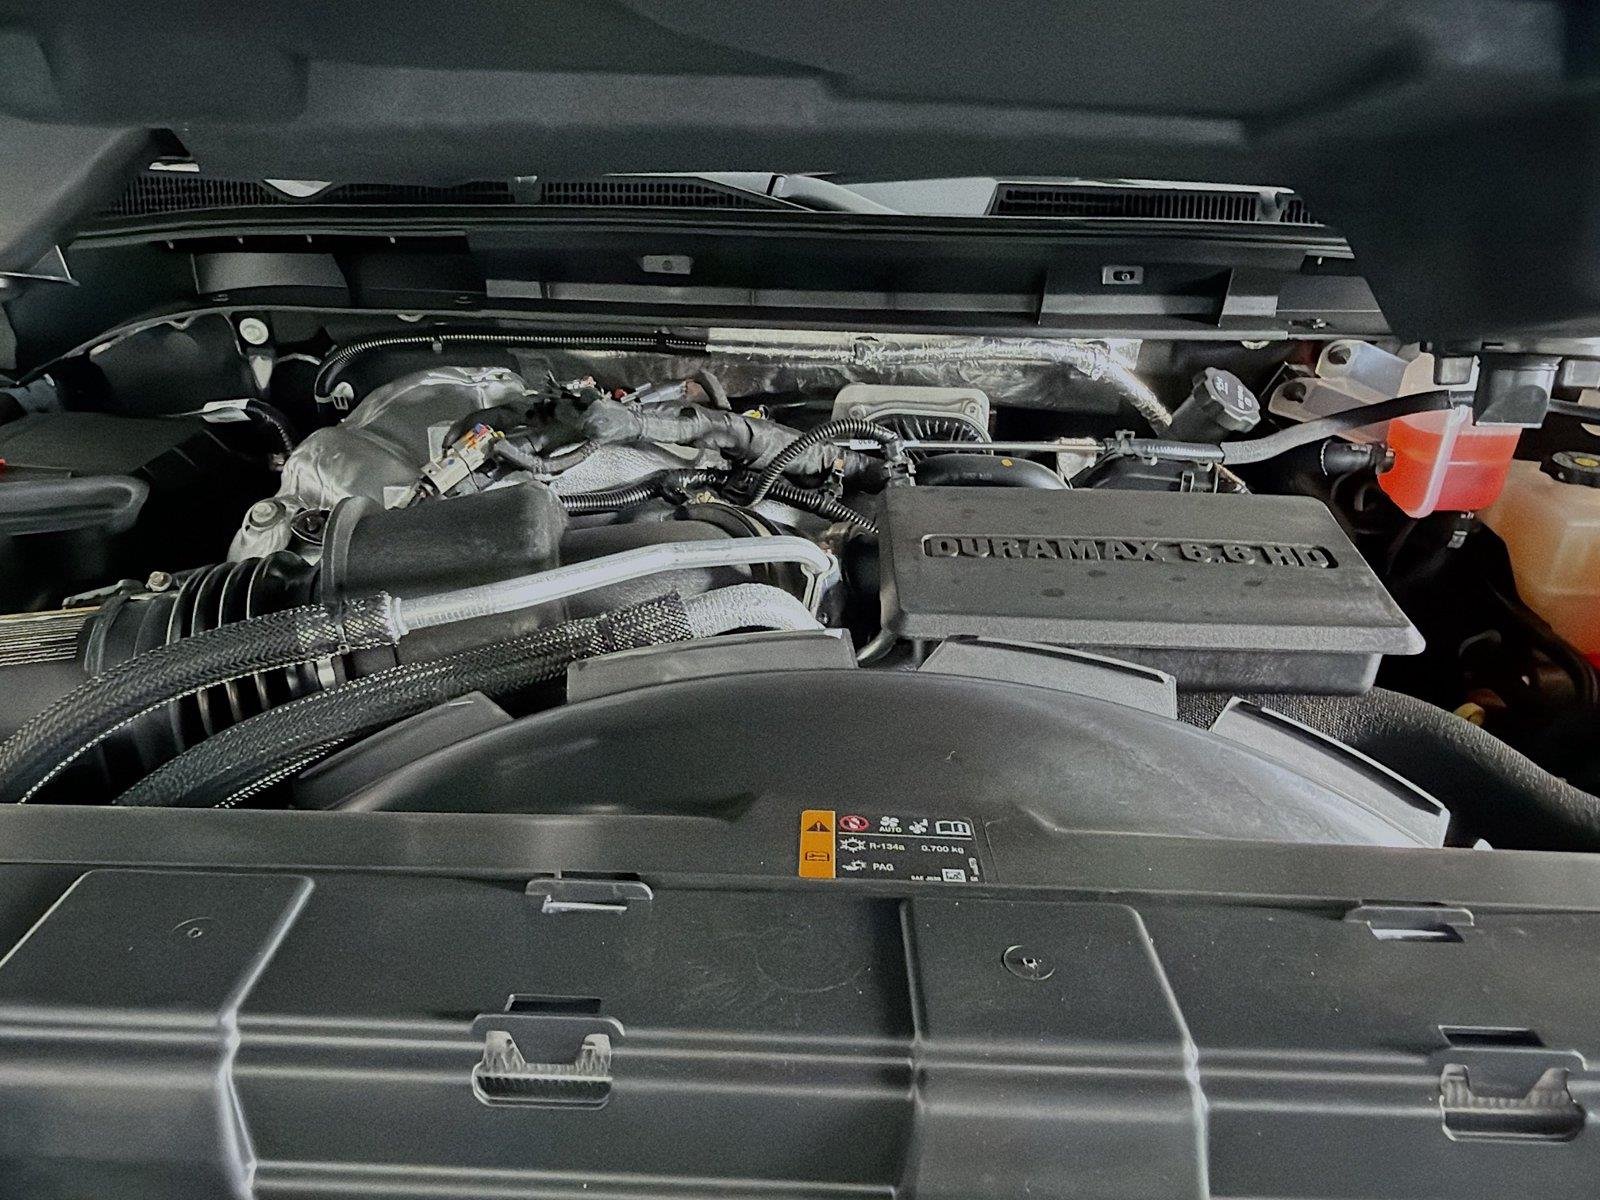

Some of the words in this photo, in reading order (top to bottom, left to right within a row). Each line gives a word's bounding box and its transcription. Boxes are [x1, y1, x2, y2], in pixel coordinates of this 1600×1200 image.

[930, 537, 1165, 562] DURAMAX
[1180, 543, 1255, 565] 6.6
[1263, 545, 1330, 568] HD
[869, 842, 905, 851] R-134a
[921, 845, 949, 853] 0.700
[951, 846, 964, 855] kg
[873, 863, 894, 871] PAG
